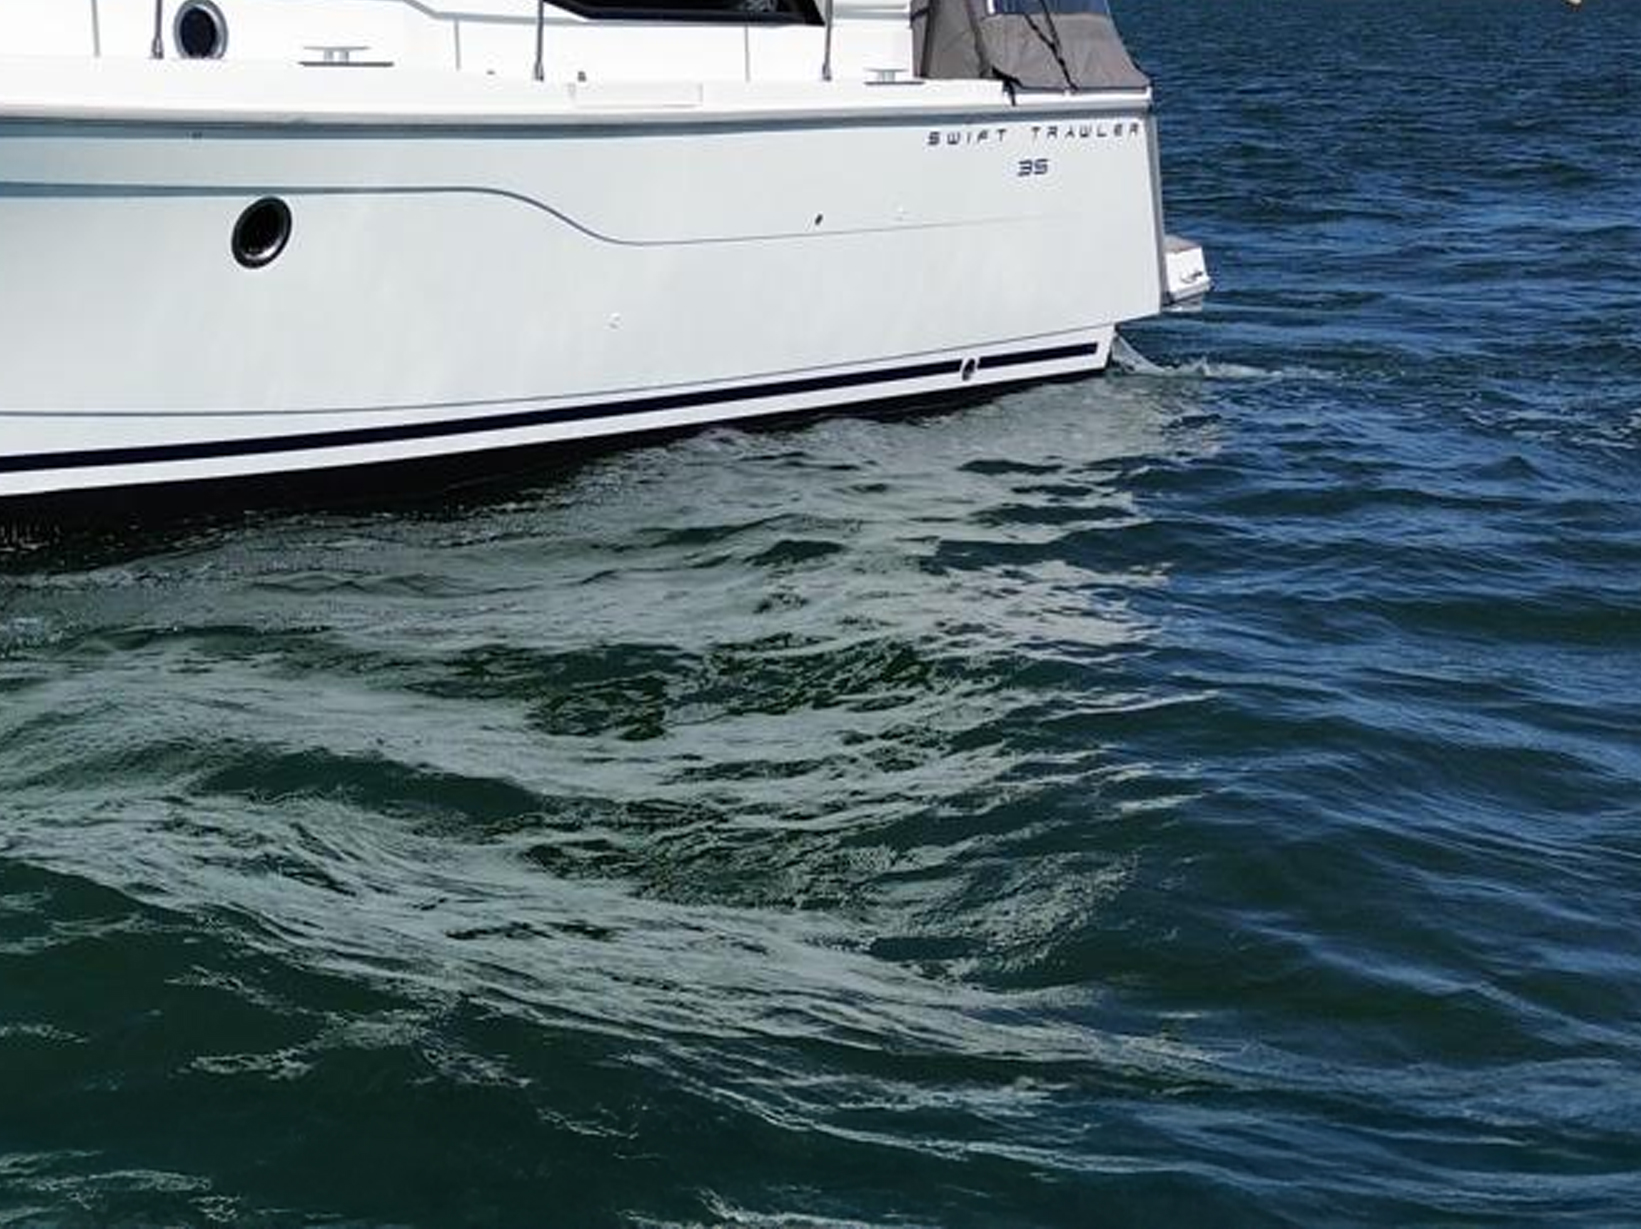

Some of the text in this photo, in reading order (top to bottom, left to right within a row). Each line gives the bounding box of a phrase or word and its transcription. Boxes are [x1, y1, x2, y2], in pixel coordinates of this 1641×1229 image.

[926, 122, 1140, 146] SWIFT TRAWLER
[1017, 158, 1049, 177] 35
